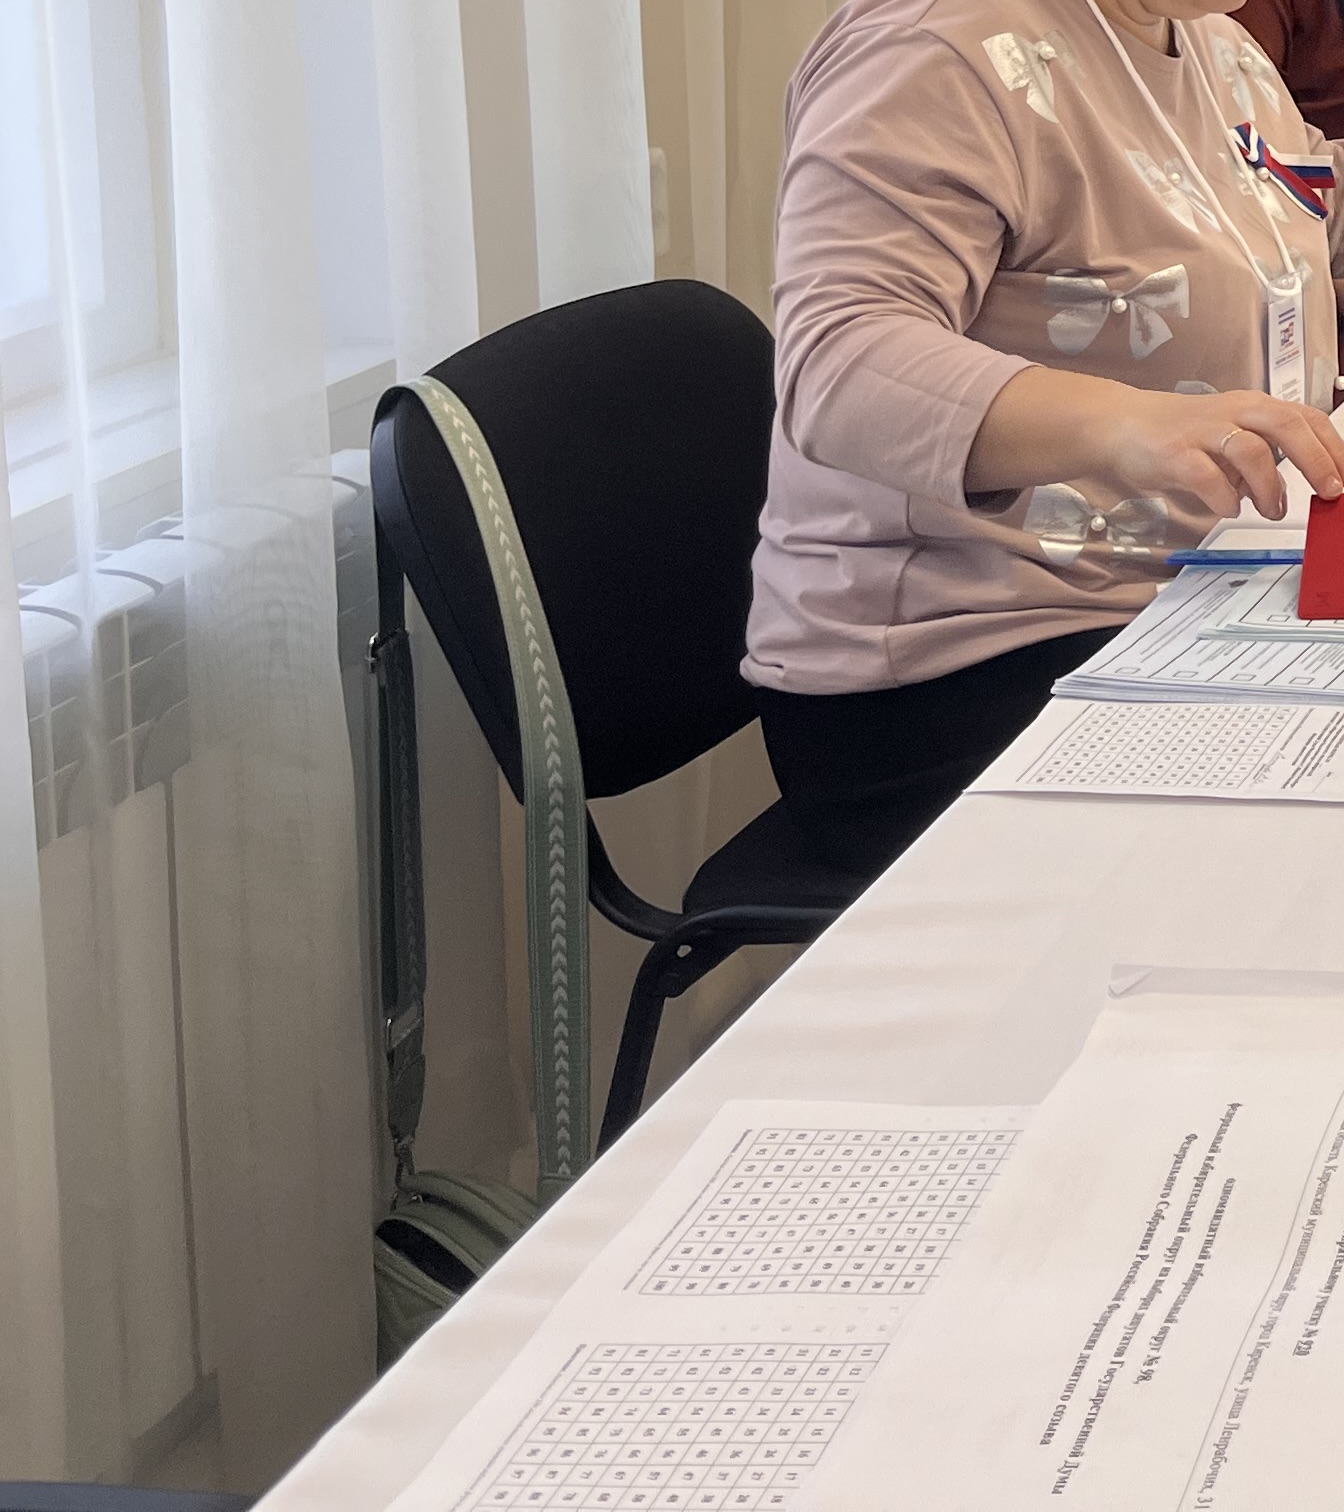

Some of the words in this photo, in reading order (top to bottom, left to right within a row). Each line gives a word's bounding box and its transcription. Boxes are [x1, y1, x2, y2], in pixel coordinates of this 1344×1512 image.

[1160, 1133, 1198, 1198] Федерального
[1178, 1155, 1214, 1232] избирательный
[1310, 1164, 1338, 1215] Киренский
[1138, 1200, 1170, 1250] Собрания
[1198, 1177, 1236, 1260] одномандатный
[1158, 1266, 1172, 1277] на
[1163, 1236, 1184, 1264] округ
[1282, 1218, 1317, 1291] муниципальный
[1112, 1254, 1150, 1301] Российской
[1164, 1262, 1204, 1323] избирательный
[1084, 1302, 1120, 1350] Федерации
[1258, 1316, 1278, 1339] город
[1304, 1295, 1330, 1326] участку
[1114, 1312, 1144, 1357] депутатов
[1148, 1326, 1170, 1352] округ
[1292, 1340, 1314, 1356] 920
[1302, 1328, 1319, 1338] №
[1060, 1352, 1090, 1401] девятого
[1142, 1354, 1160, 1366] №
[1240, 1341, 1270, 1384] Киренск,
[1040, 1404, 1066, 1445] созыва
[1069, 1360, 1124, 1457] Государственной
[1228, 1388, 1249, 1419] улица
[1052, 1460, 1080, 1494] Думы
[1198, 1421, 1240, 1494] Ленрабочих,
[1194, 1496, 1214, 1510] 31
